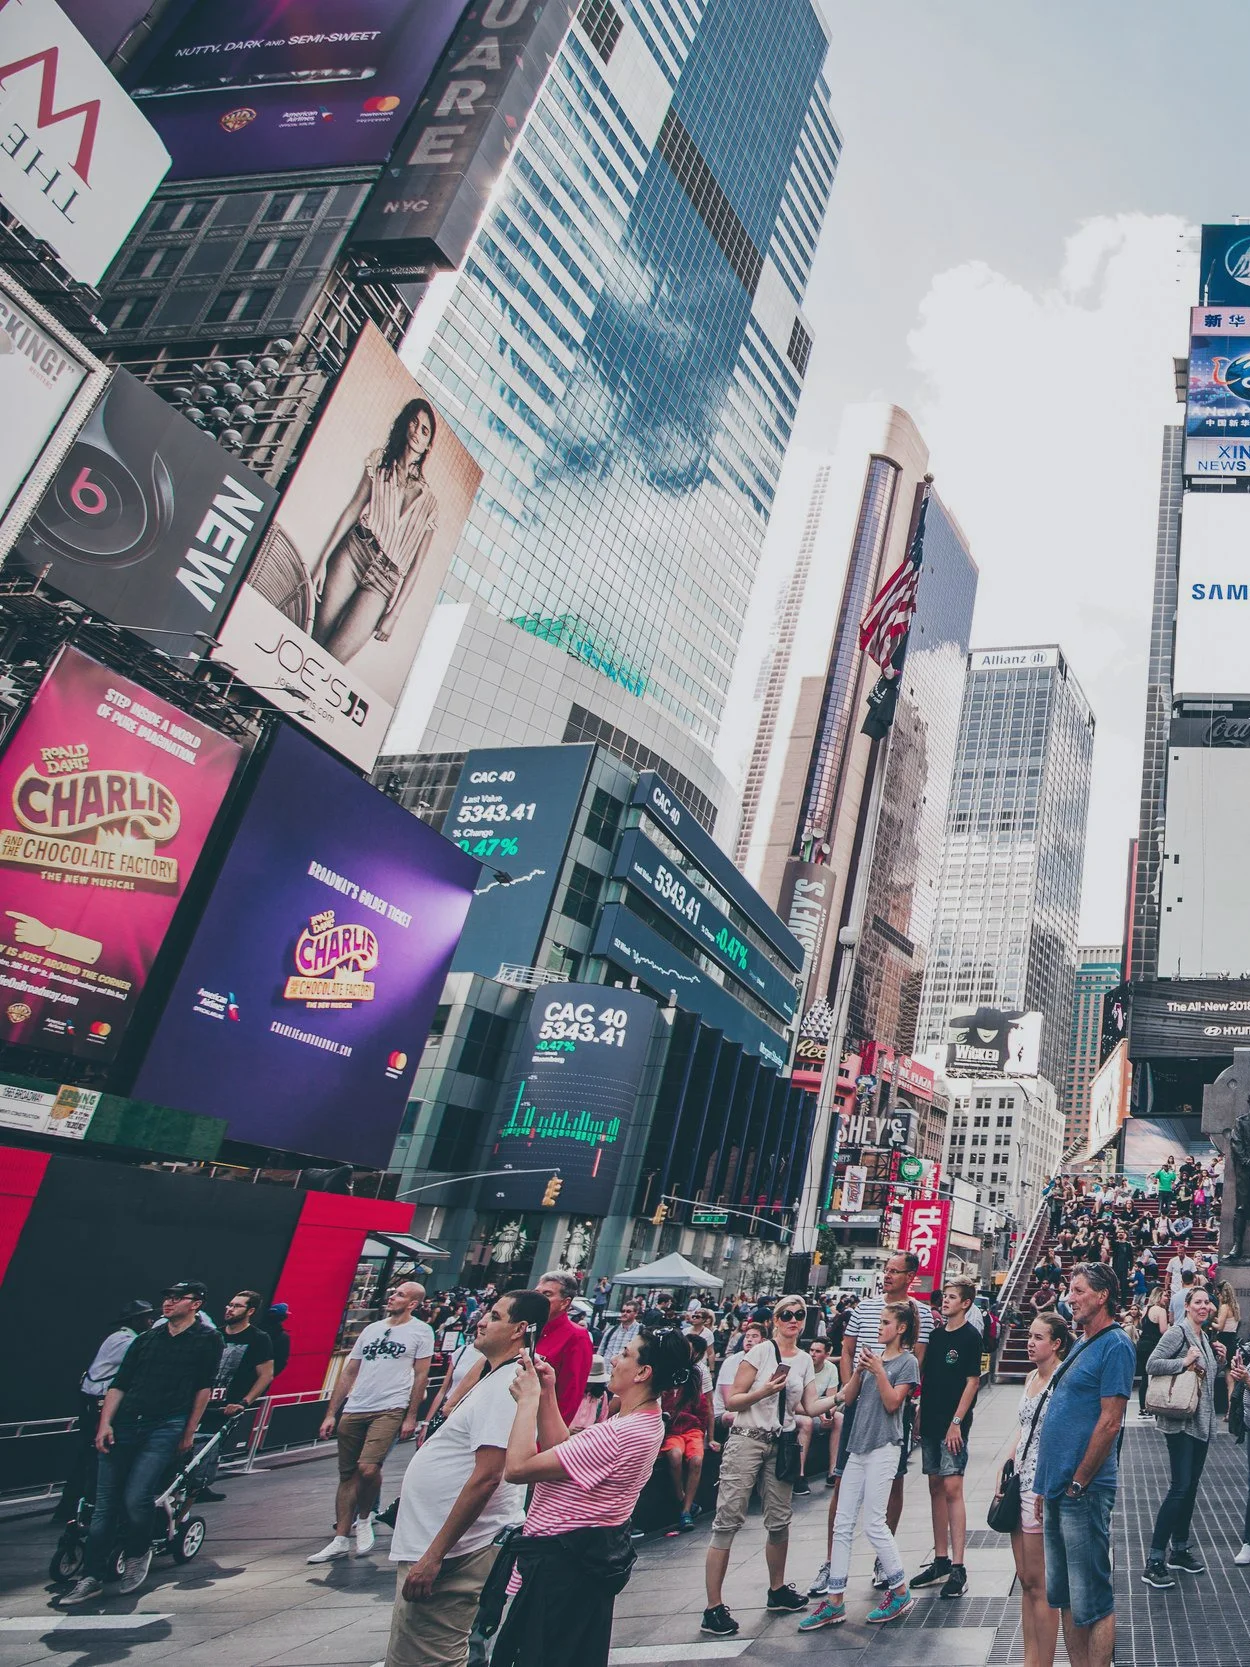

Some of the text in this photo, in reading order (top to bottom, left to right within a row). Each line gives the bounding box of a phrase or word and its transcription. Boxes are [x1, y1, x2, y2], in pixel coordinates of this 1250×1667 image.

[224, 39, 264, 51] DARK
[265, 39, 285, 47] AND
[288, 31, 381, 45] SEMI-SWEET
[282, 110, 318, 118] American
[383, 200, 429, 214] NYC
[1205, 406, 1237, 417] New
[1198, 460, 1246, 472] NEWS
[176, 474, 265, 613] NEW
[981, 654, 1027, 666] Allianz
[254, 633, 348, 709] JOE'S
[96, 703, 114, 719] OF
[110, 710, 139, 734] PURE
[105, 688, 132, 709] STEP
[160, 719, 170, 733] A
[168, 723, 202, 749] WORLD
[40, 744, 89, 761] ROALD
[469, 770, 516, 783] CAC 40
[18, 774, 174, 827] CHARLIE
[481, 794, 503, 804] Value
[653, 787, 681, 826] CAC 40
[456, 803, 537, 823] 5343.41
[4, 834, 23, 847] AND
[462, 829, 494, 838] Change
[2, 839, 176, 880] THE CHOCOLATE FACTORY
[40, 871, 135, 891] THE NEW MUSICAL
[308, 860, 413, 929] BROADWAY'S GOLDEN TICKET
[654, 864, 702, 926] 5343.41
[715, 927, 748, 970] +0.47%
[299, 928, 375, 970] CHARLIE
[811, 909, 828, 974] MILK CHOCOLATE
[6, 946, 132, 991] IS JUST AROUND THE CORNER
[197, 988, 229, 1005] American
[300, 980, 373, 997] CHOCOLATE FACTORY
[544, 1002, 628, 1029] CAC 40
[1167, 1001, 1188, 1012] The
[1187, 1001, 1229, 1012] All-New
[538, 1021, 626, 1047] 5343.41
[909, 1205, 942, 1269] tkts
[848, 1275, 866, 1283] FedEx
